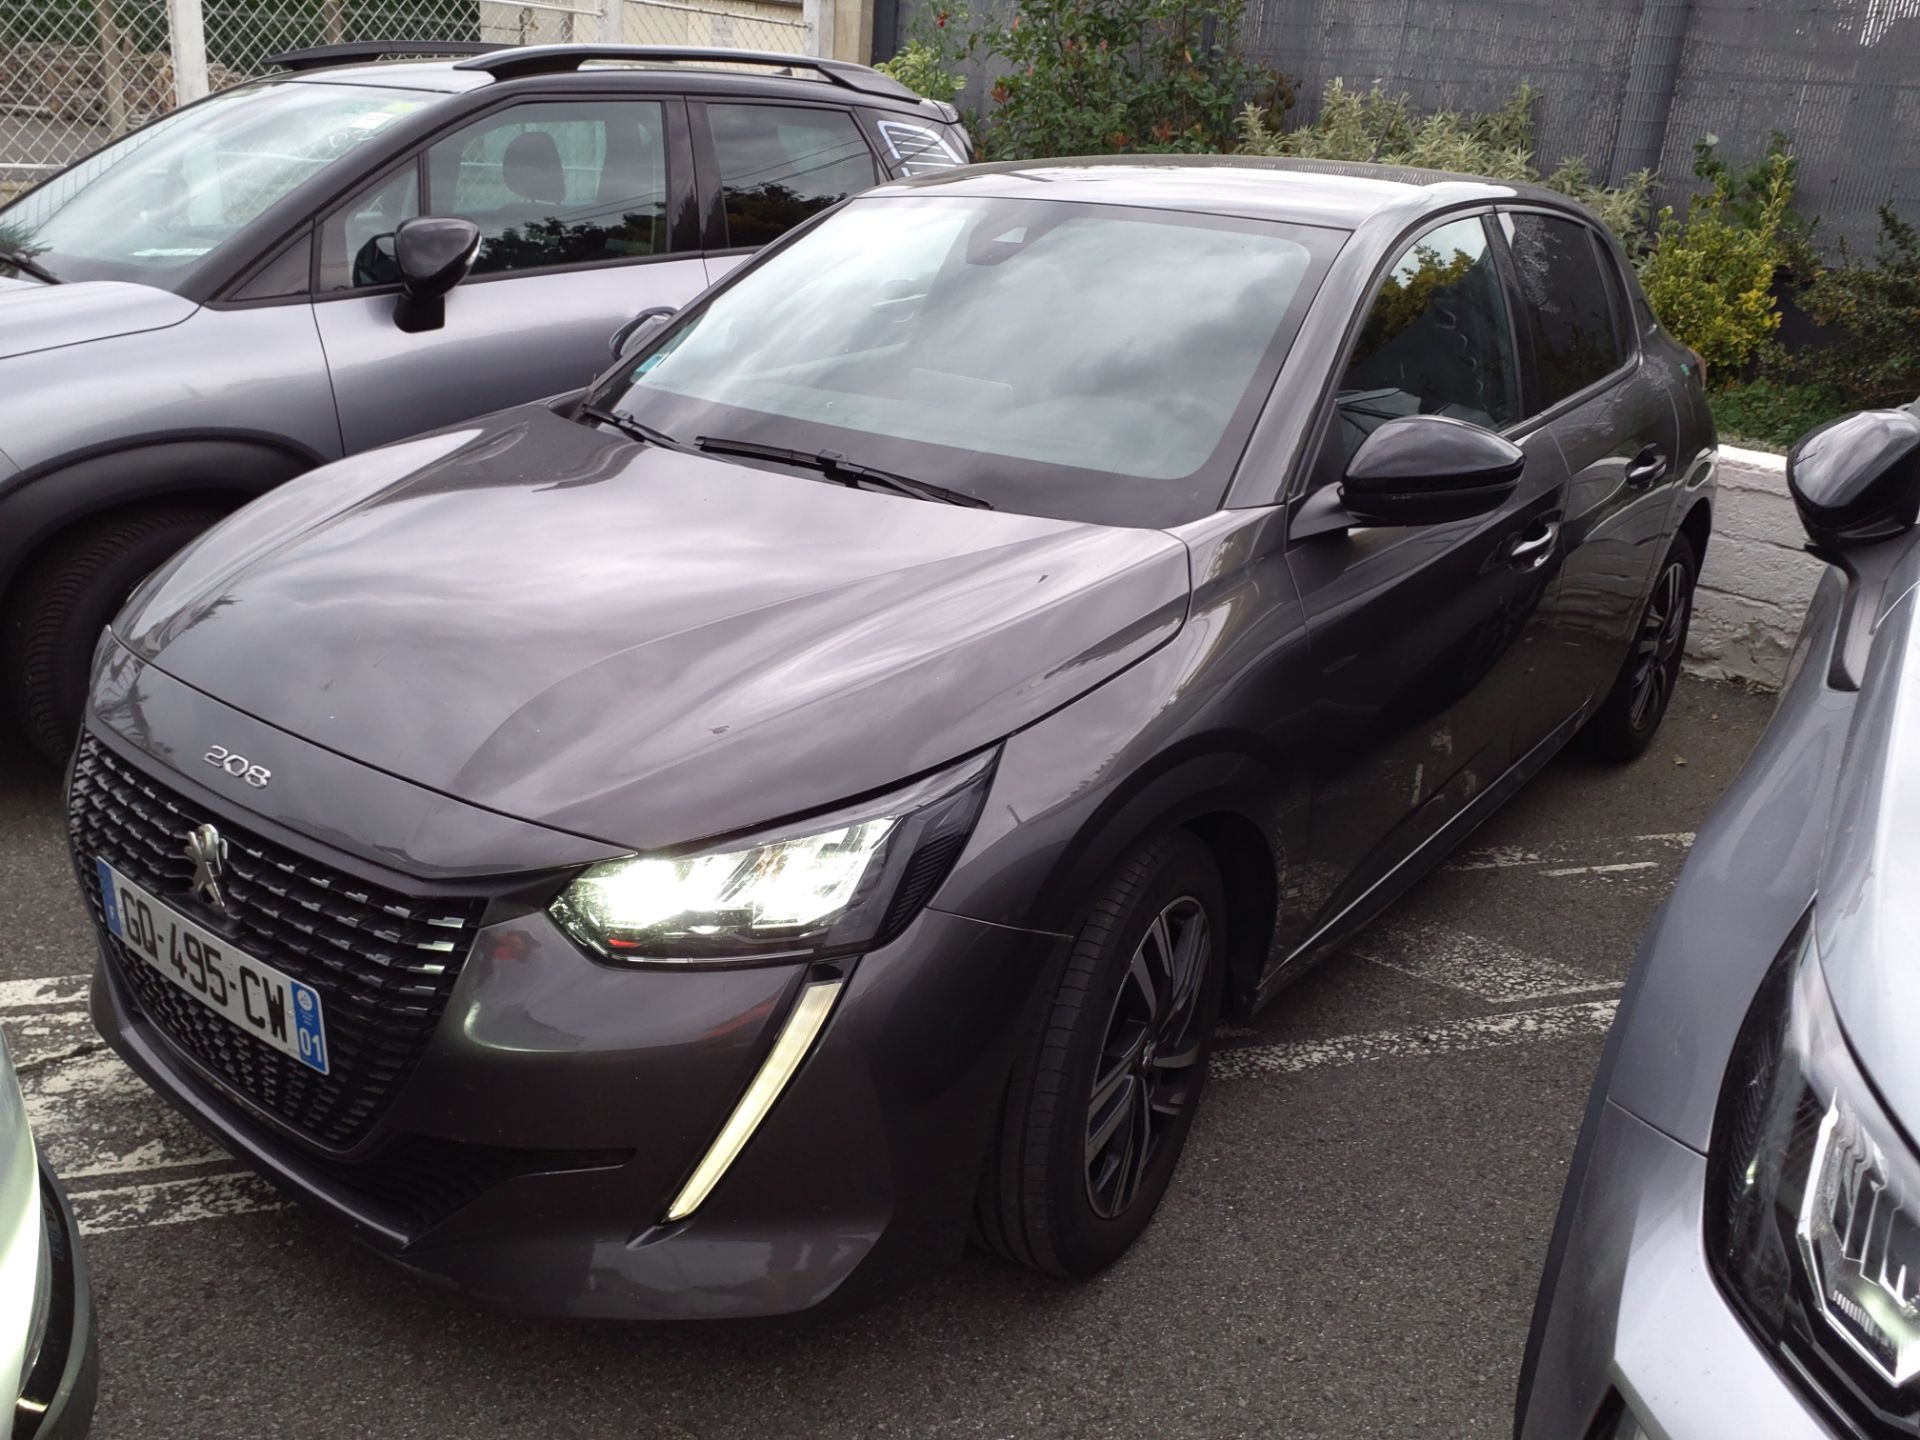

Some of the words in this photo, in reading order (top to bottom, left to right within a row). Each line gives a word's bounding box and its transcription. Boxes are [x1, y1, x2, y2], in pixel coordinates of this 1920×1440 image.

[203, 744, 272, 788] 208
[120, 887, 288, 1043] GQ-495-CW
[300, 1028, 322, 1063] 01
